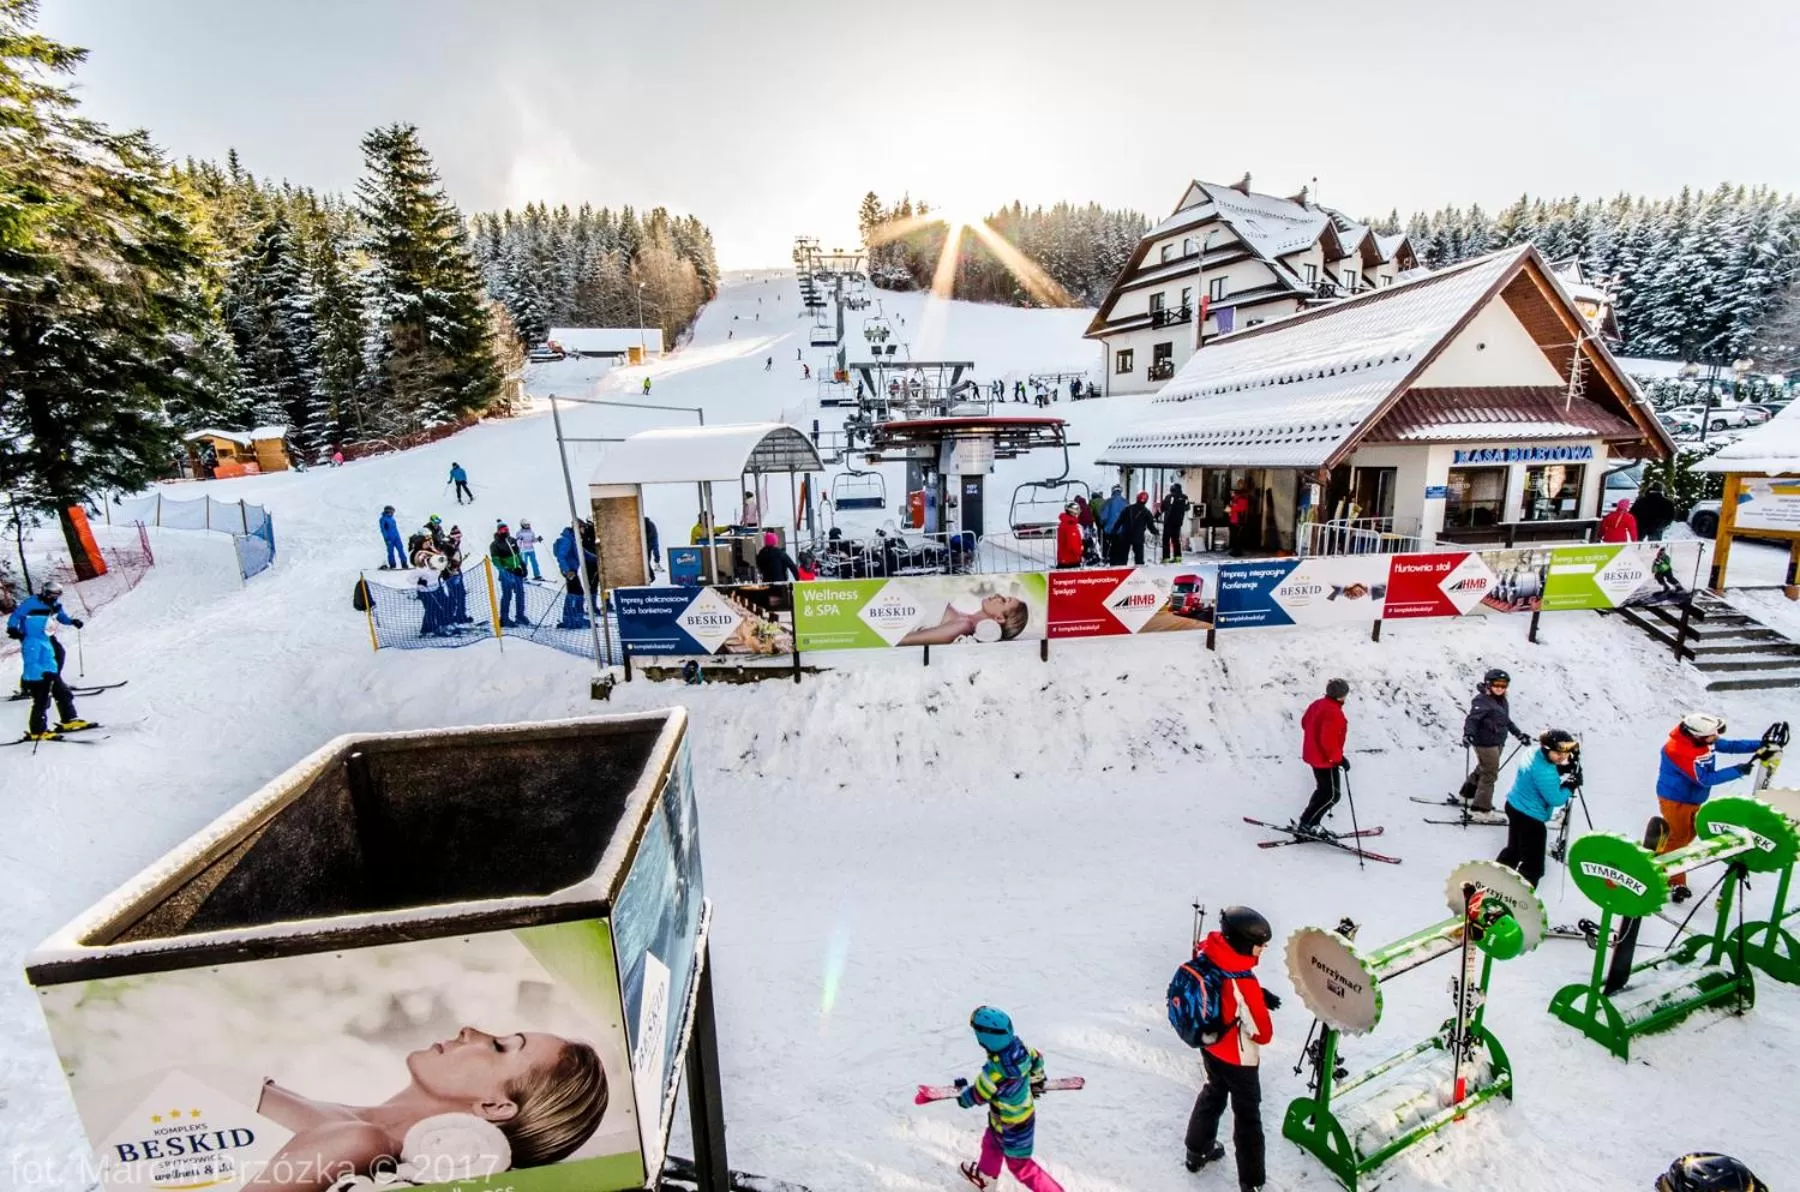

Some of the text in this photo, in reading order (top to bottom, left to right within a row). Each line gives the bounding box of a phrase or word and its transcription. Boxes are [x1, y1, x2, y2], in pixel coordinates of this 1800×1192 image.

[1456, 445, 1593, 464] KASA BILETOWA
[1394, 562, 1451, 573] Hurtownia stali
[1603, 571, 1642, 582] BESKID
[1462, 578, 1487, 590] HMB
[803, 588, 858, 602] Wellness
[1280, 585, 1322, 597] BESKID
[1128, 594, 1156, 607] HMB
[803, 604, 840, 616] & SPA
[869, 606, 916, 618] BESKID
[687, 614, 732, 626] BESKID
[1711, 824, 1771, 850] TYRK
[1583, 863, 1643, 894] TYMBARK
[153, 1123, 209, 1137] KOMPLEKS
[114, 1127, 256, 1163] BESKID
[203, 1164, 214, 1175] &
